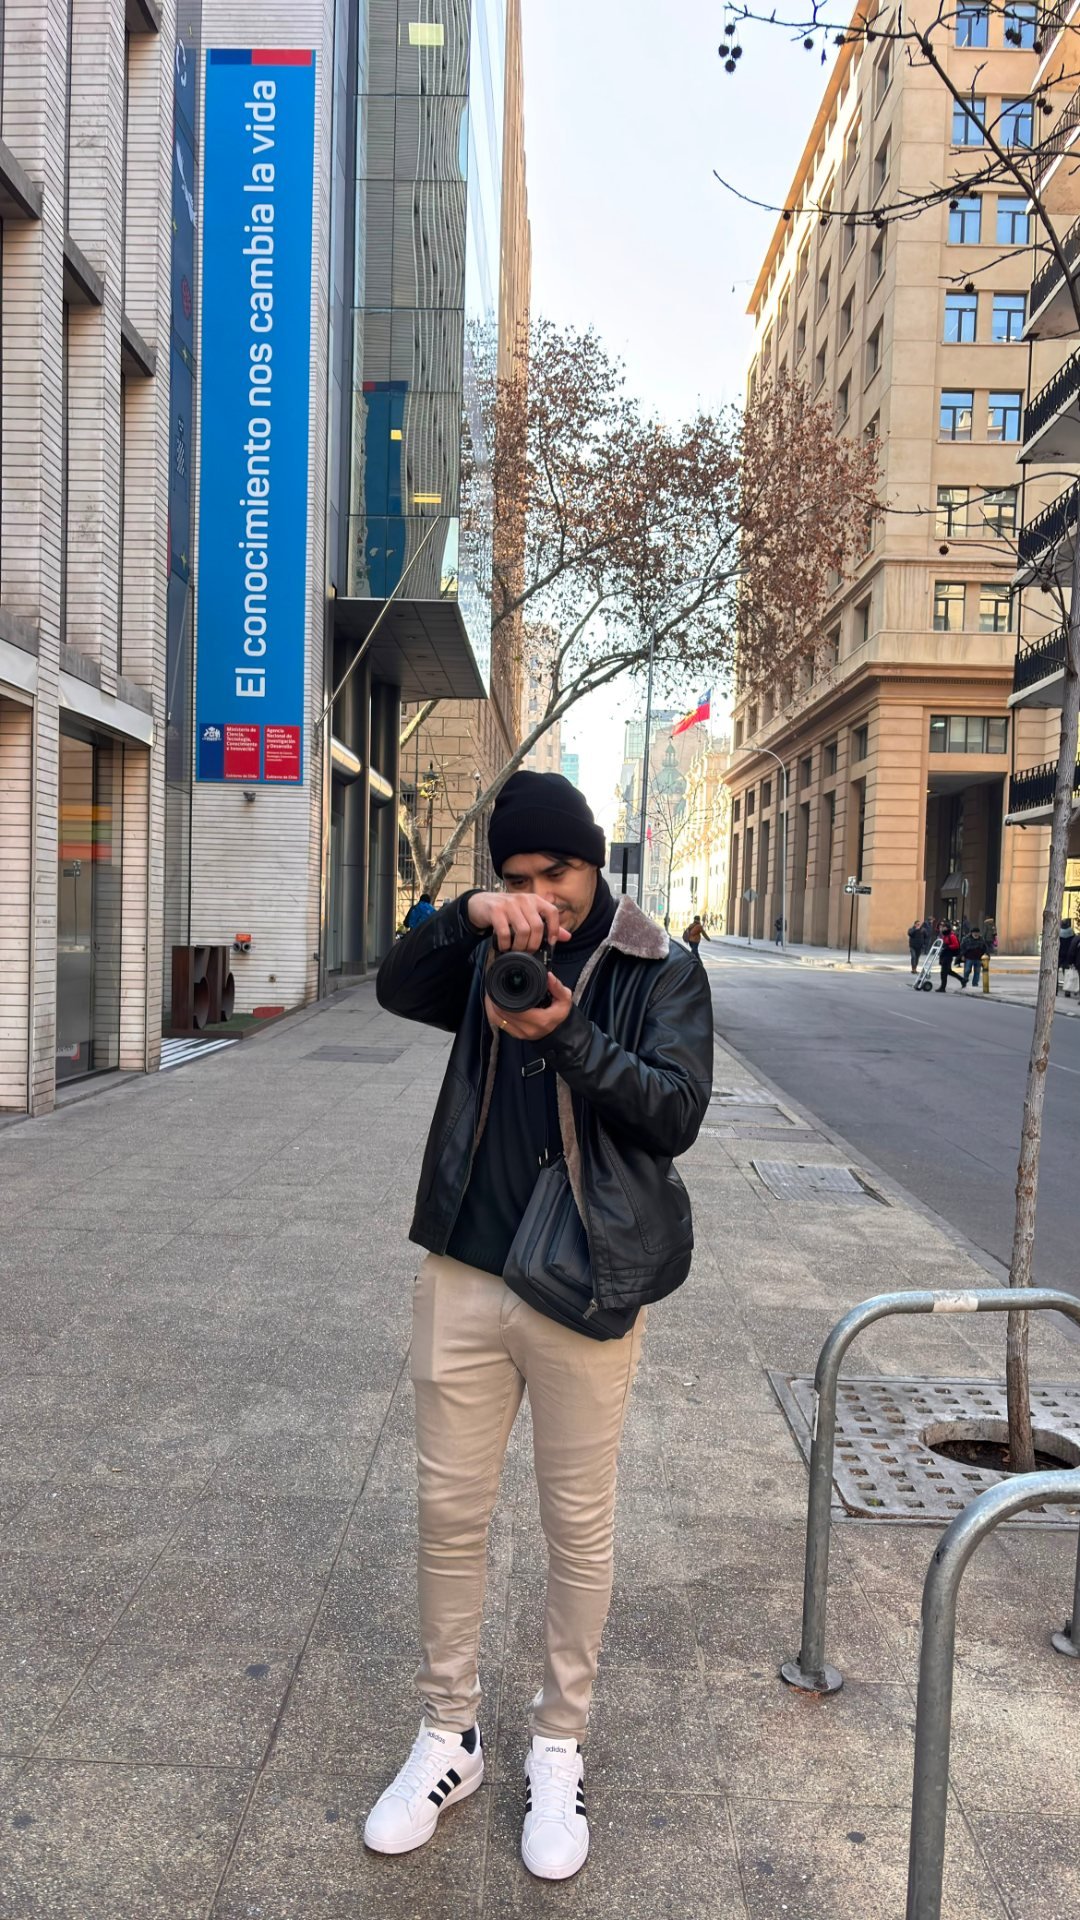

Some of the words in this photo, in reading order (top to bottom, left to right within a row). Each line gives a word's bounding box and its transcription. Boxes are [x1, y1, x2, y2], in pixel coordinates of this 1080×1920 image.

[245, 80, 276, 153] vida
[244, 163, 274, 191] la
[243, 203, 273, 332] cambia
[249, 343, 271, 406] nos
[239, 417, 267, 656] conocimiento
[236, 667, 265, 696] El
[427, 1731, 446, 1745] adidas
[545, 1745, 567, 1754] adidas
